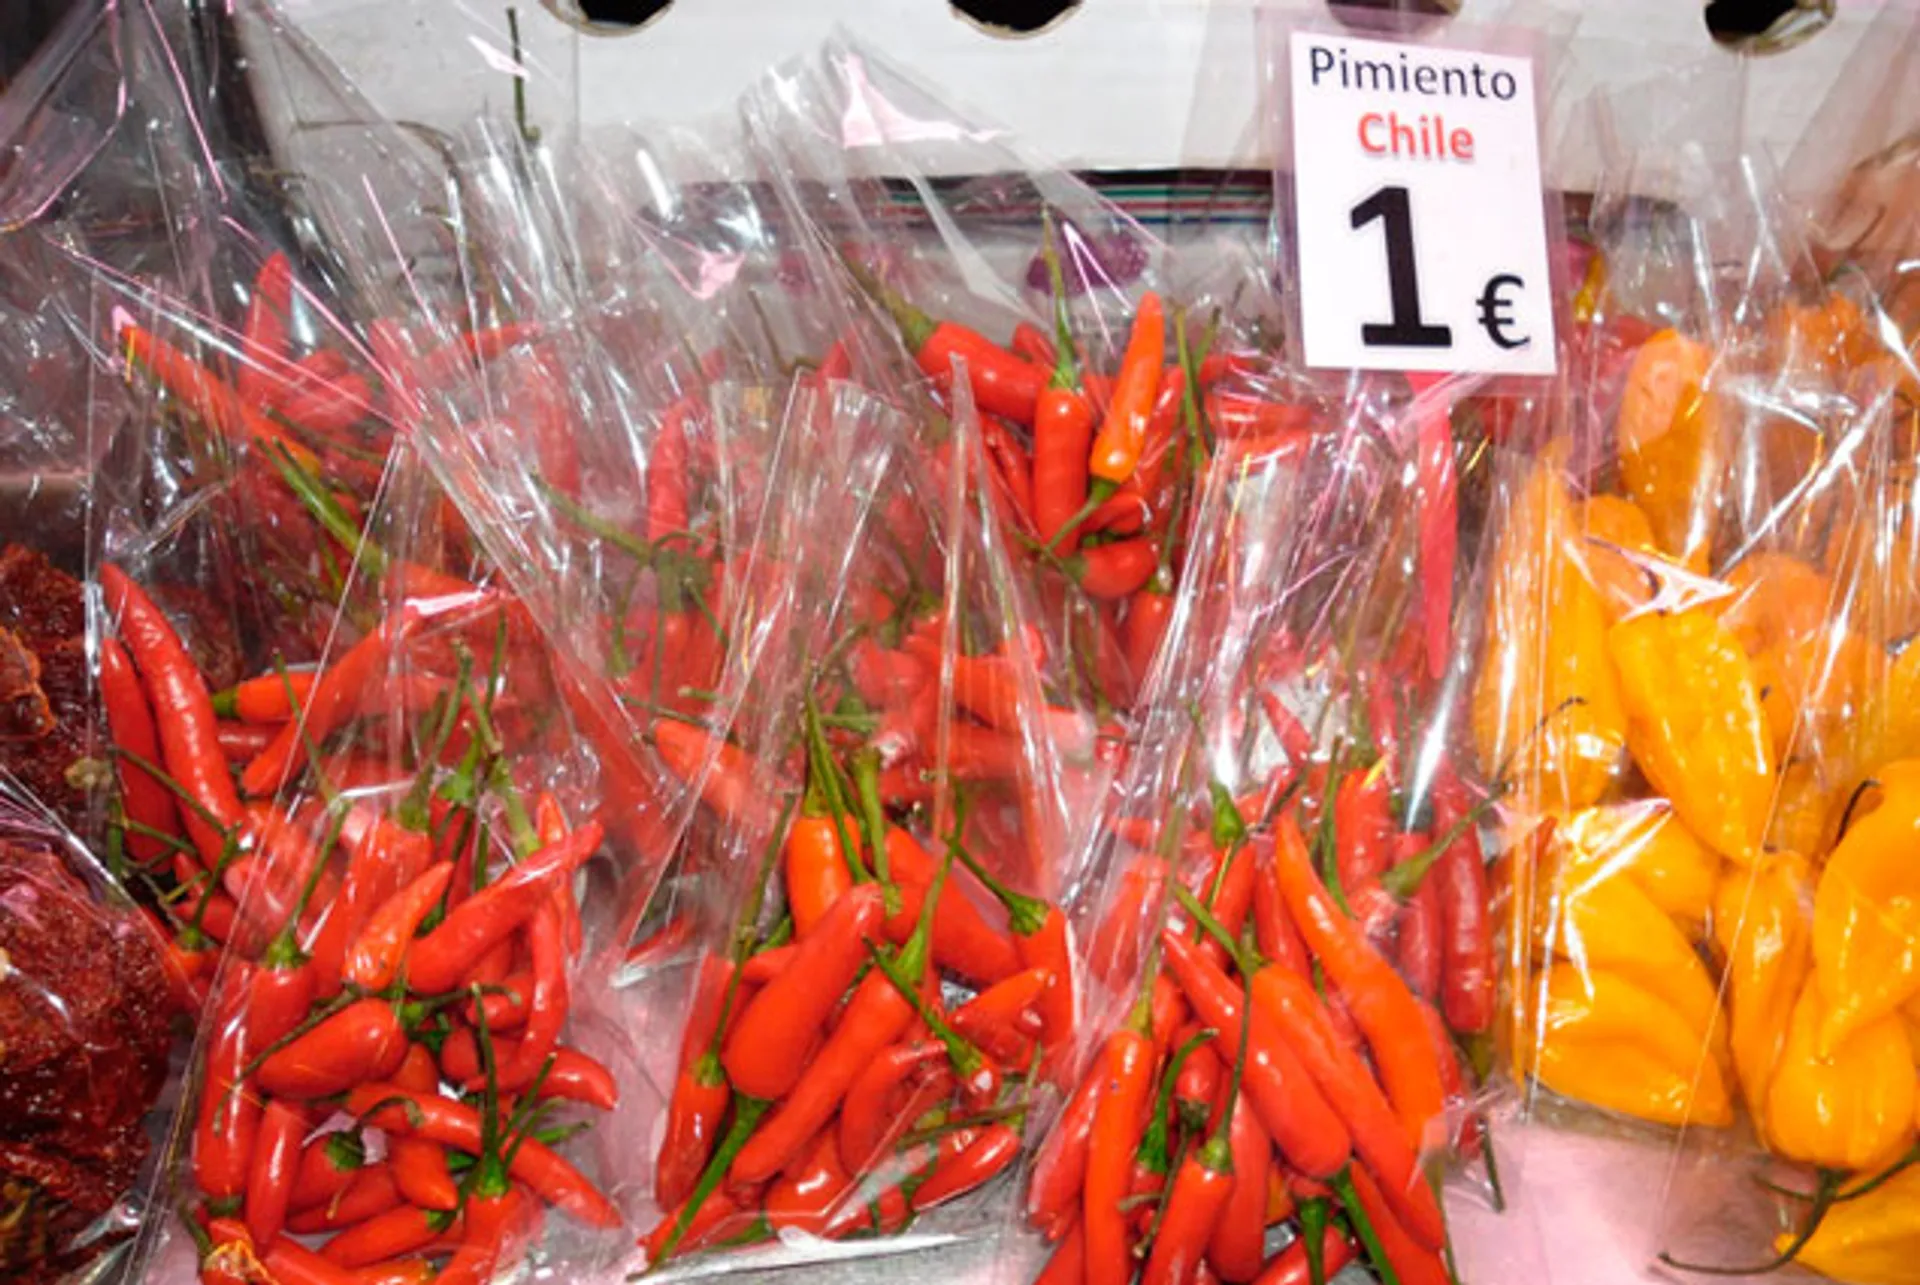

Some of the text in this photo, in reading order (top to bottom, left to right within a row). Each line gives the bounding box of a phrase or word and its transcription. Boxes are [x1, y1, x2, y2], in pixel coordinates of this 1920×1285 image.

[1310, 47, 1517, 100] Pimiento
[1357, 111, 1475, 160] Chile
[1350, 185, 1531, 349] 1 €
